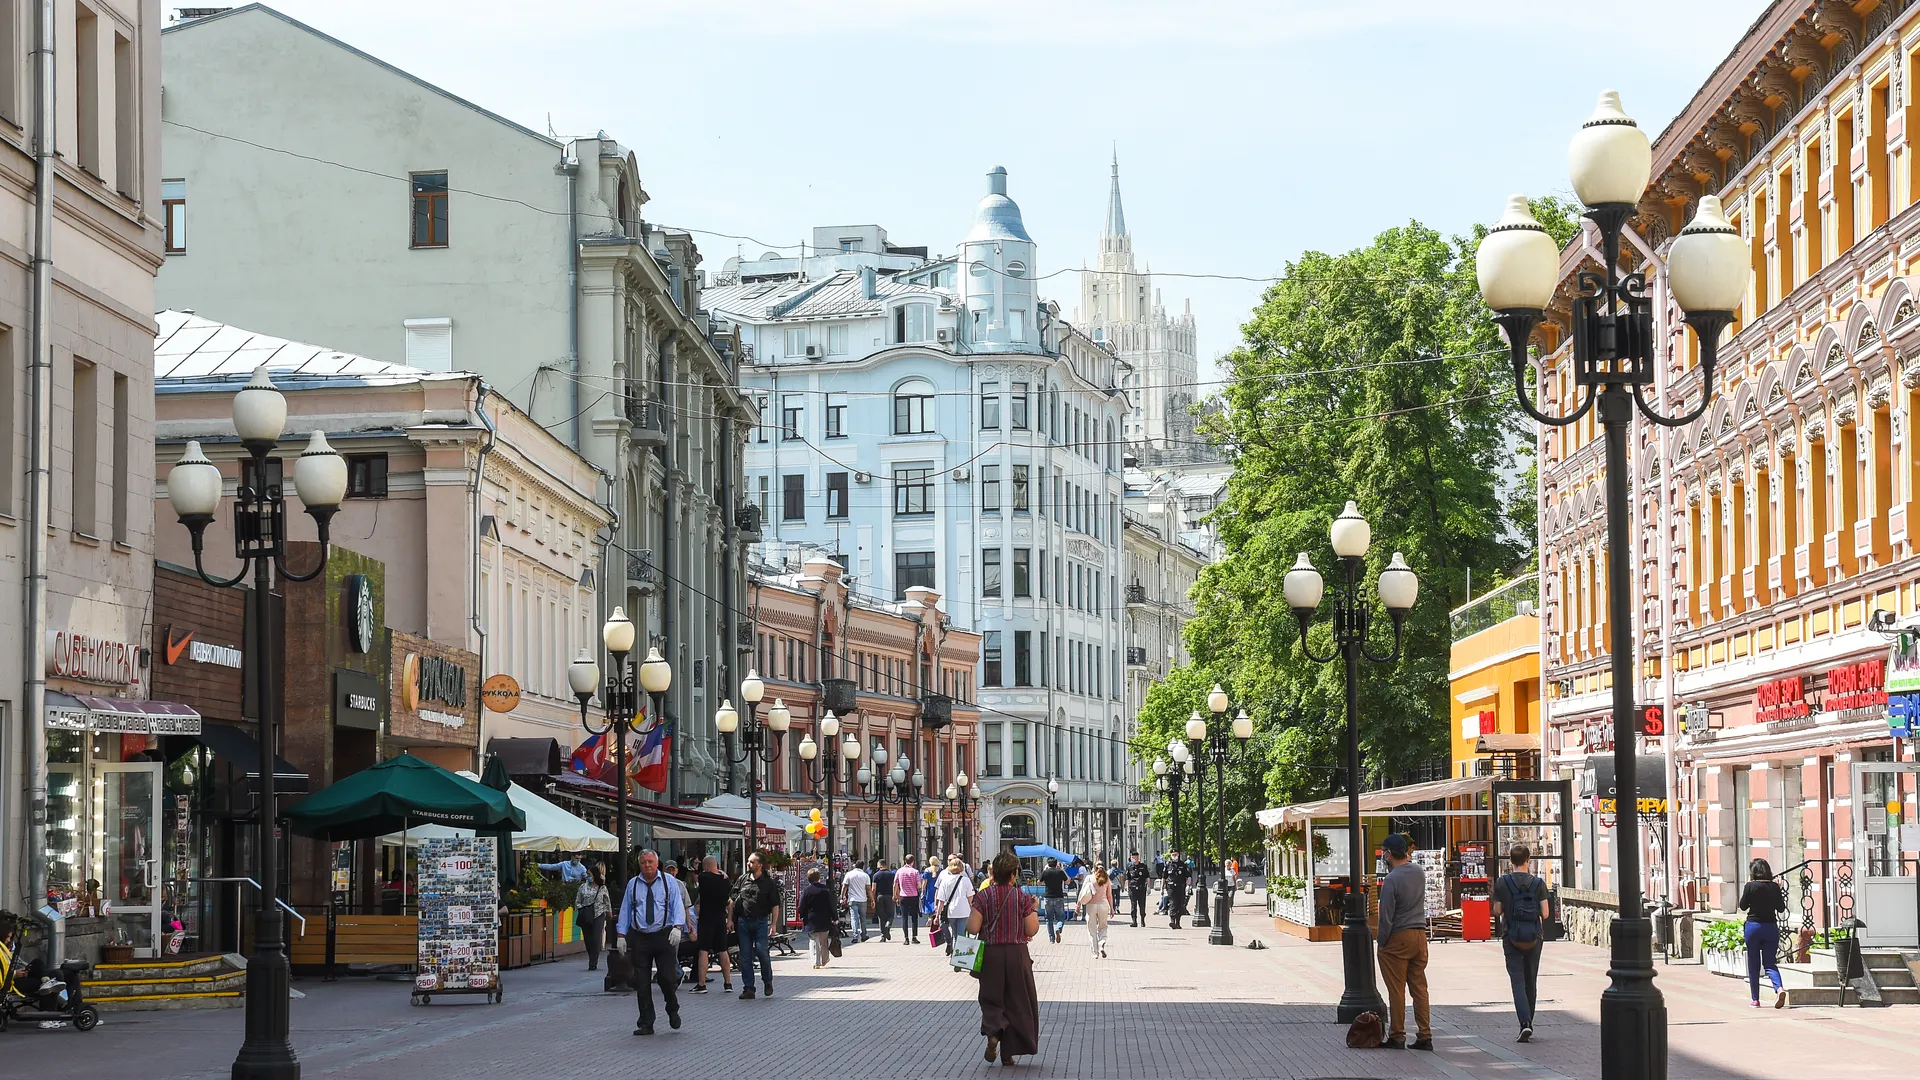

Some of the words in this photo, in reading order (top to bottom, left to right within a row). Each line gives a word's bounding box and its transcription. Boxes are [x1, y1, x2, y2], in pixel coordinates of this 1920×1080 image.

[1827, 665, 1857, 695] НОВАЯ
[1857, 659, 1884, 689] ЗАРЯ
[350, 693, 376, 711] STARBUCKS
[1756, 681, 1780, 707] НОВАЯ
[1780, 676, 1803, 703] ЗАРЯ
[412, 809, 449, 819] STARBUCKS
